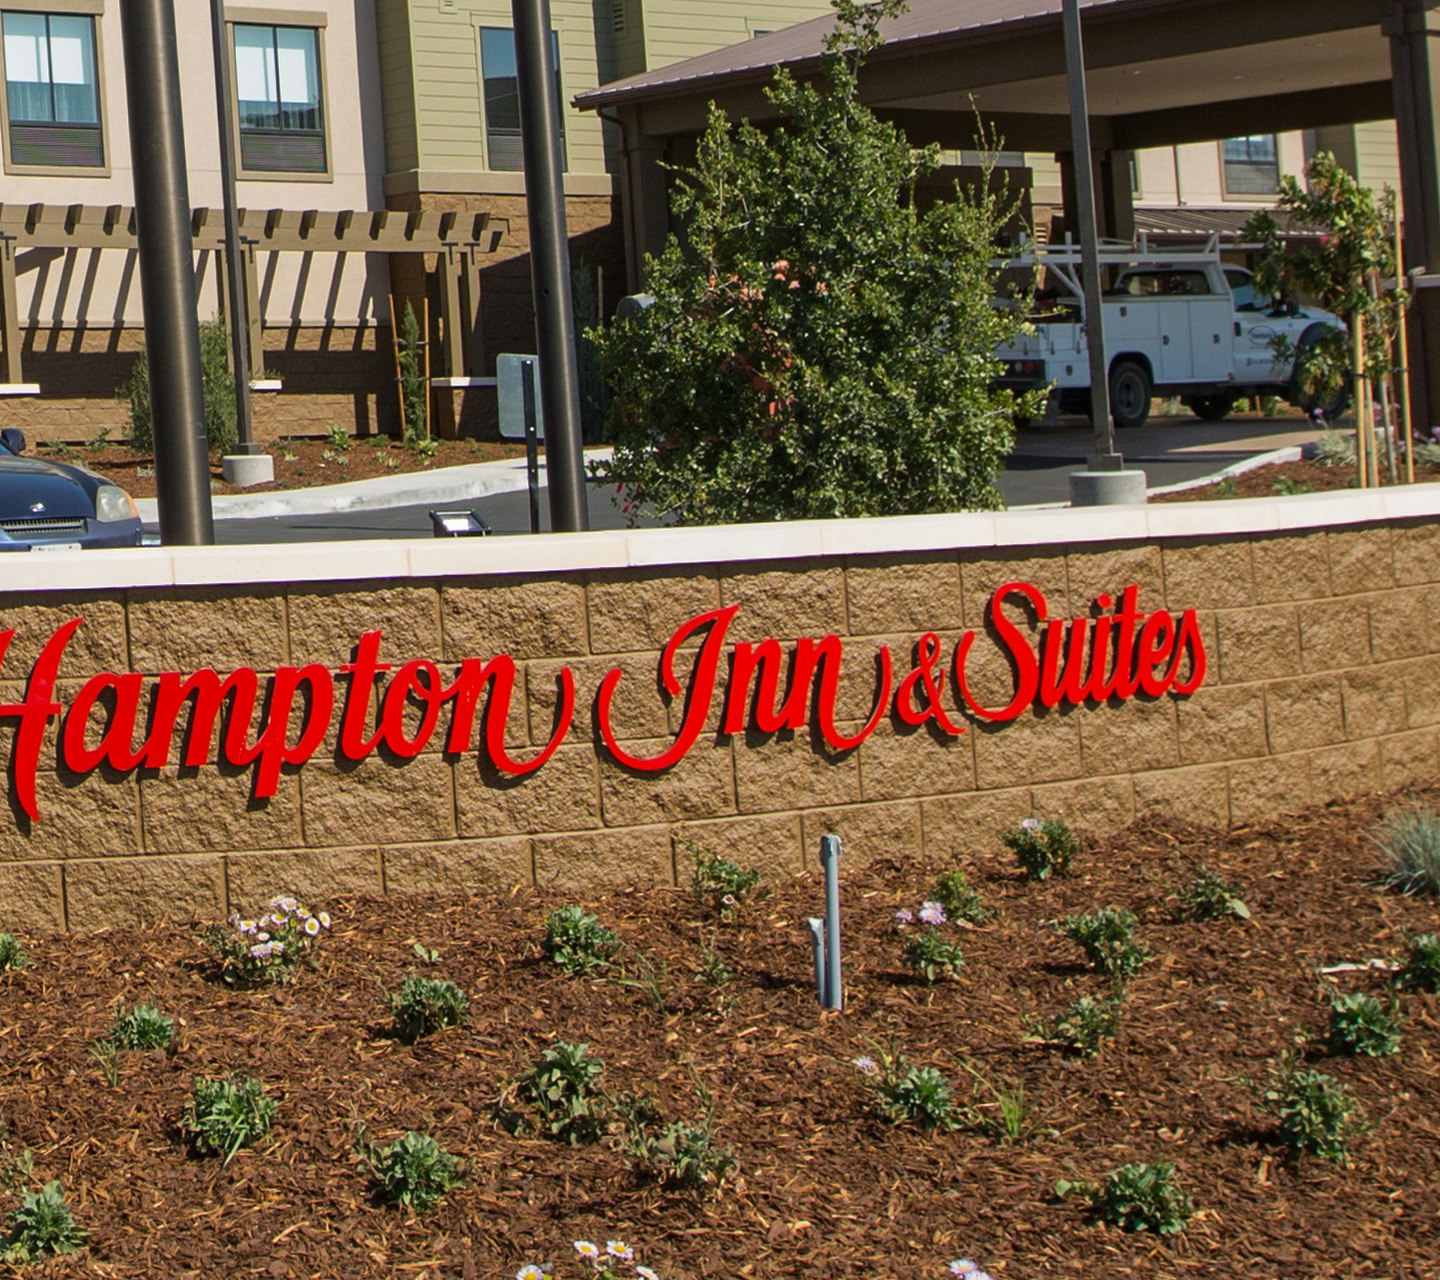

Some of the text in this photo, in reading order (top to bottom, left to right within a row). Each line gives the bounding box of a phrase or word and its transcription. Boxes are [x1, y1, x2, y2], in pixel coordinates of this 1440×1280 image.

[599, 603, 895, 771] Inn
[897, 632, 966, 735] &
[956, 581, 1207, 722] Suites
